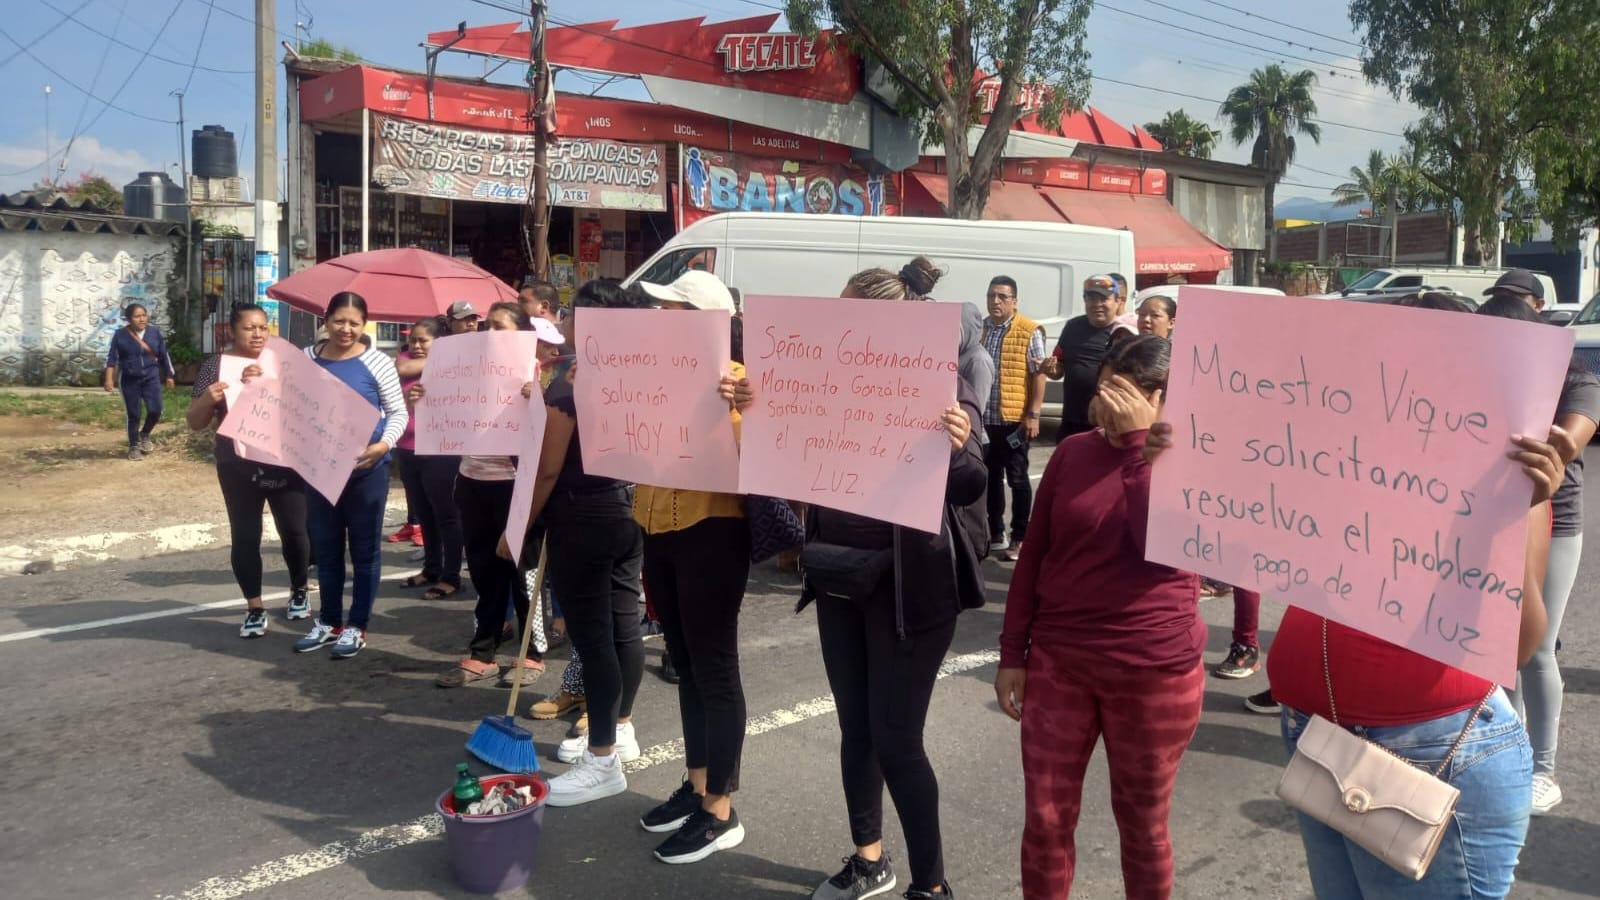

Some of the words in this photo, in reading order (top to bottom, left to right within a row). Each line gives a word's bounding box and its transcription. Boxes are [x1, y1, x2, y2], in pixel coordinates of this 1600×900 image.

[715, 33, 817, 72] TECATE
[382, 119, 505, 152] RECARGAS
[752, 136, 766, 146] LAS
[768, 137, 800, 150] ADELITAS
[406, 146, 482, 175] TODAS
[488, 155, 529, 178] LAS
[546, 160, 652, 187] OMPAÑIAS
[562, 190, 590, 201] AT&T
[710, 161, 865, 216] BAÑOS
[760, 325, 822, 360] Señora
[851, 375, 921, 399] González
[1191, 343, 1352, 415] Maestro
[1380, 361, 1489, 453] Vique
[252, 404, 271, 420] No
[624, 412, 663, 457] HOY
[775, 425, 789, 449] el
[869, 436, 886, 458] de
[1190, 414, 1217, 455] le
[1240, 423, 1477, 516] solicitamos
[1182, 483, 1323, 539] resuelva
[1343, 512, 1370, 555] el
[1392, 531, 1523, 613] problema
[1183, 524, 1222, 564] del
[1253, 552, 1309, 593] pago
[1323, 564, 1353, 600] de
[1377, 578, 1405, 624] la
[1426, 593, 1488, 657] luz
